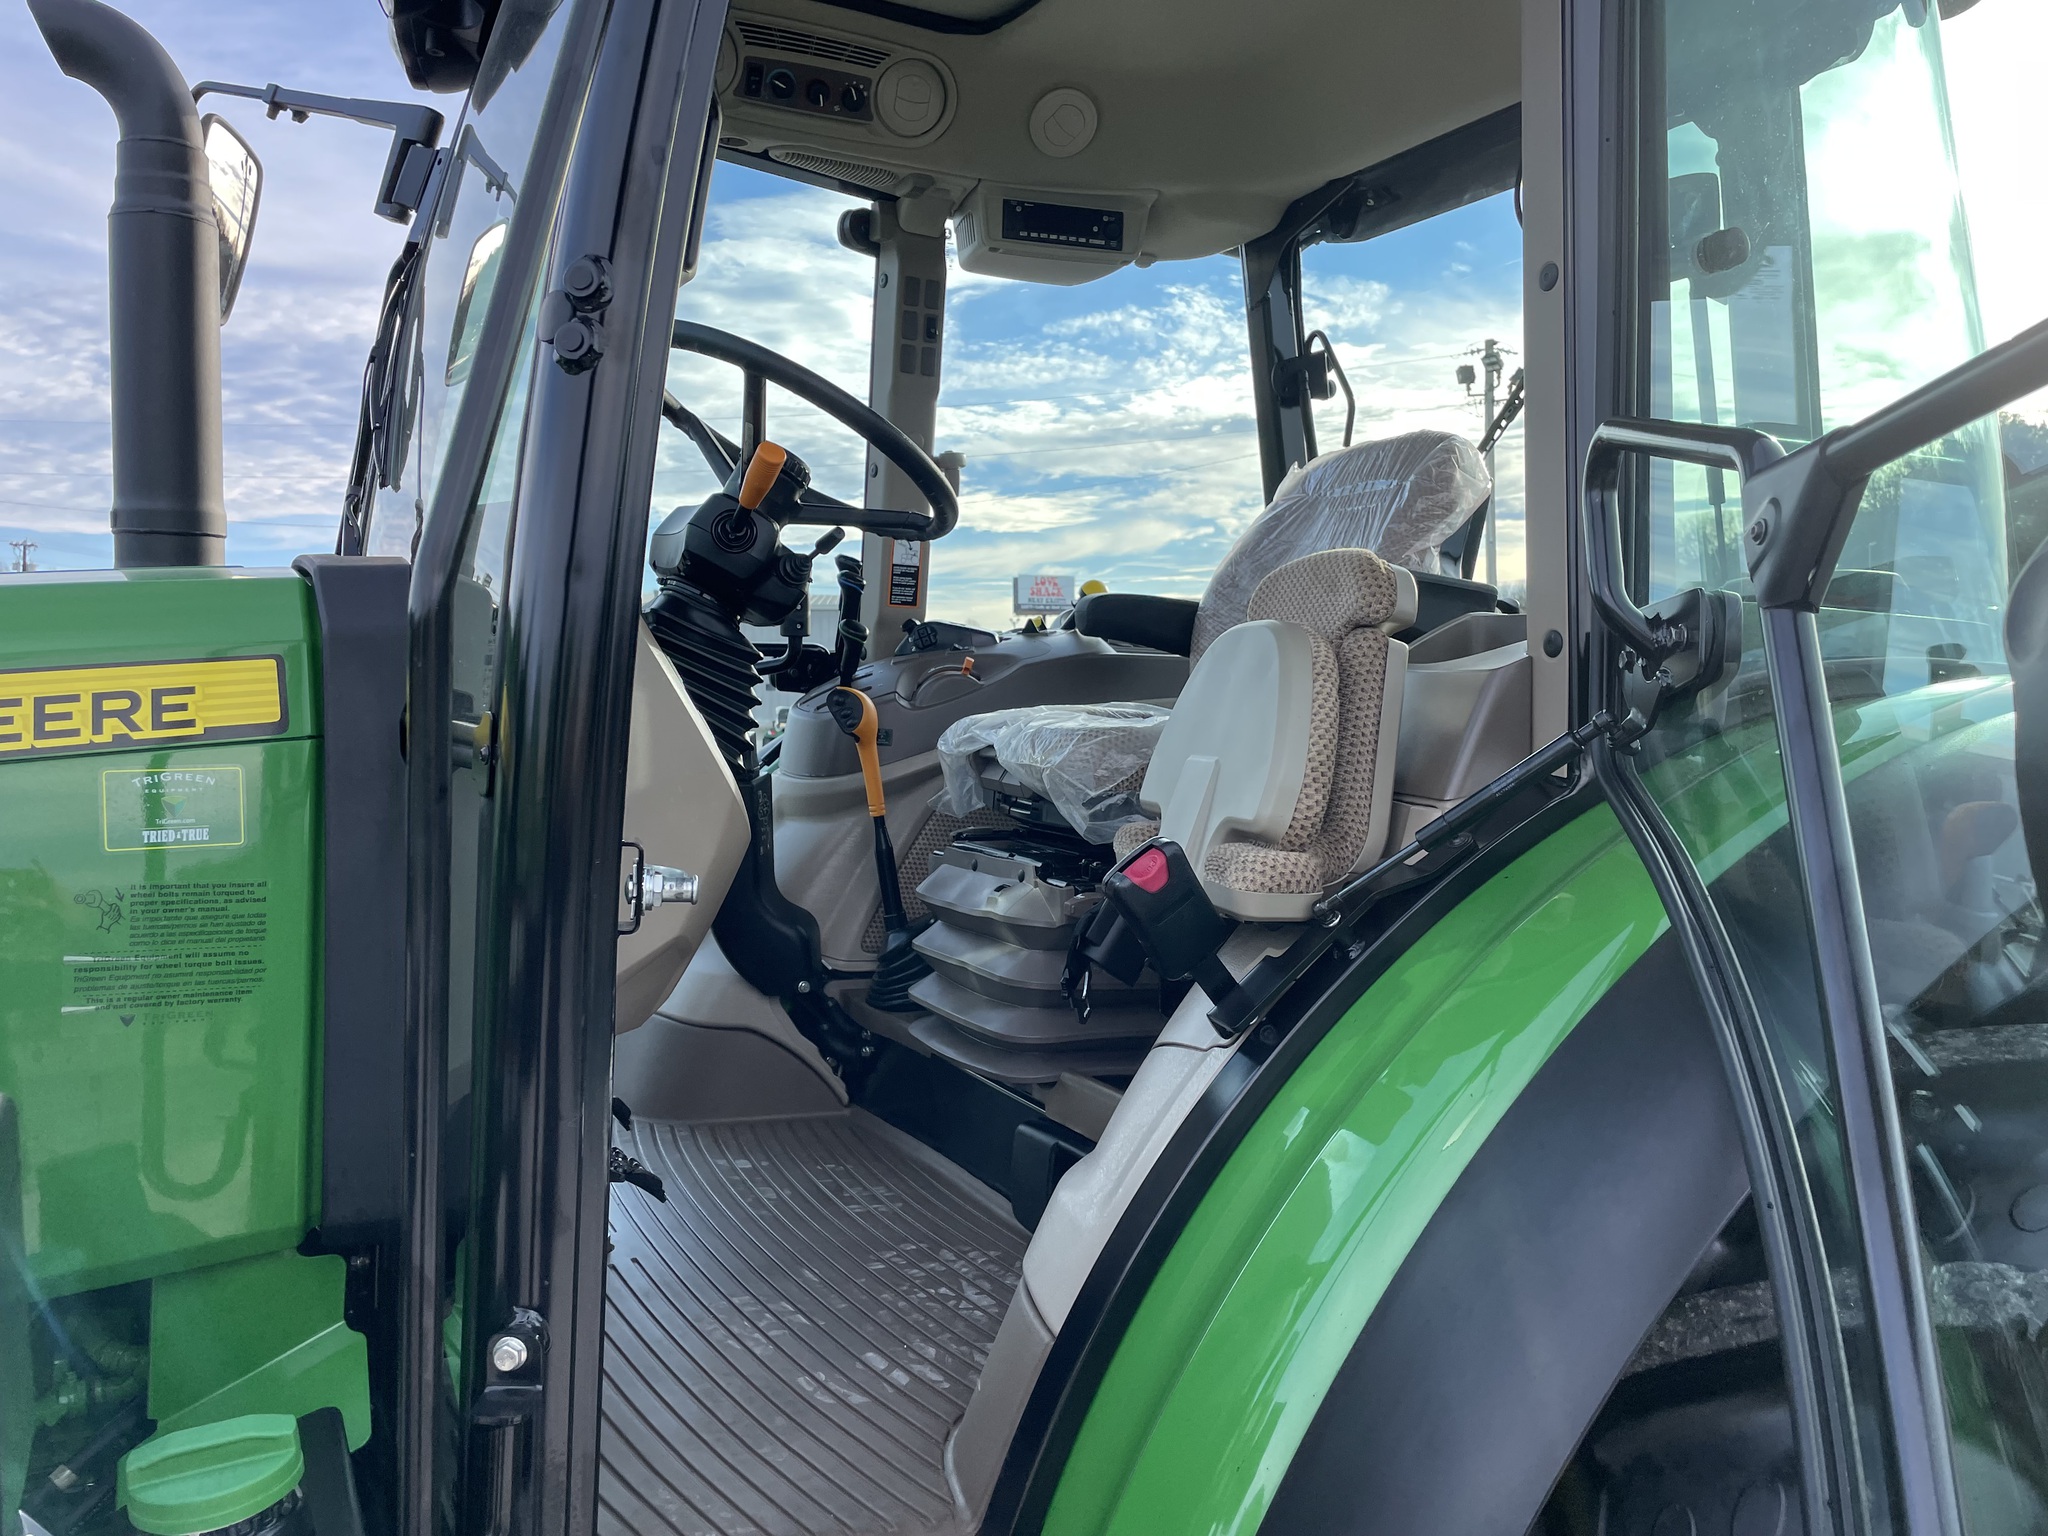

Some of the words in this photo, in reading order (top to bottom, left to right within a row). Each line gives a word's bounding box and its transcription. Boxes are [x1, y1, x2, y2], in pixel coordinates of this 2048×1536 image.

[1030, 587, 1064, 597] SHACK
[132, 772, 215, 787] TRIGREEN
[142, 830, 175, 843] TRIED
[182, 828, 209, 842] TRUE
[74, 966, 136, 974] responsibility
[177, 998, 204, 1007] factory
